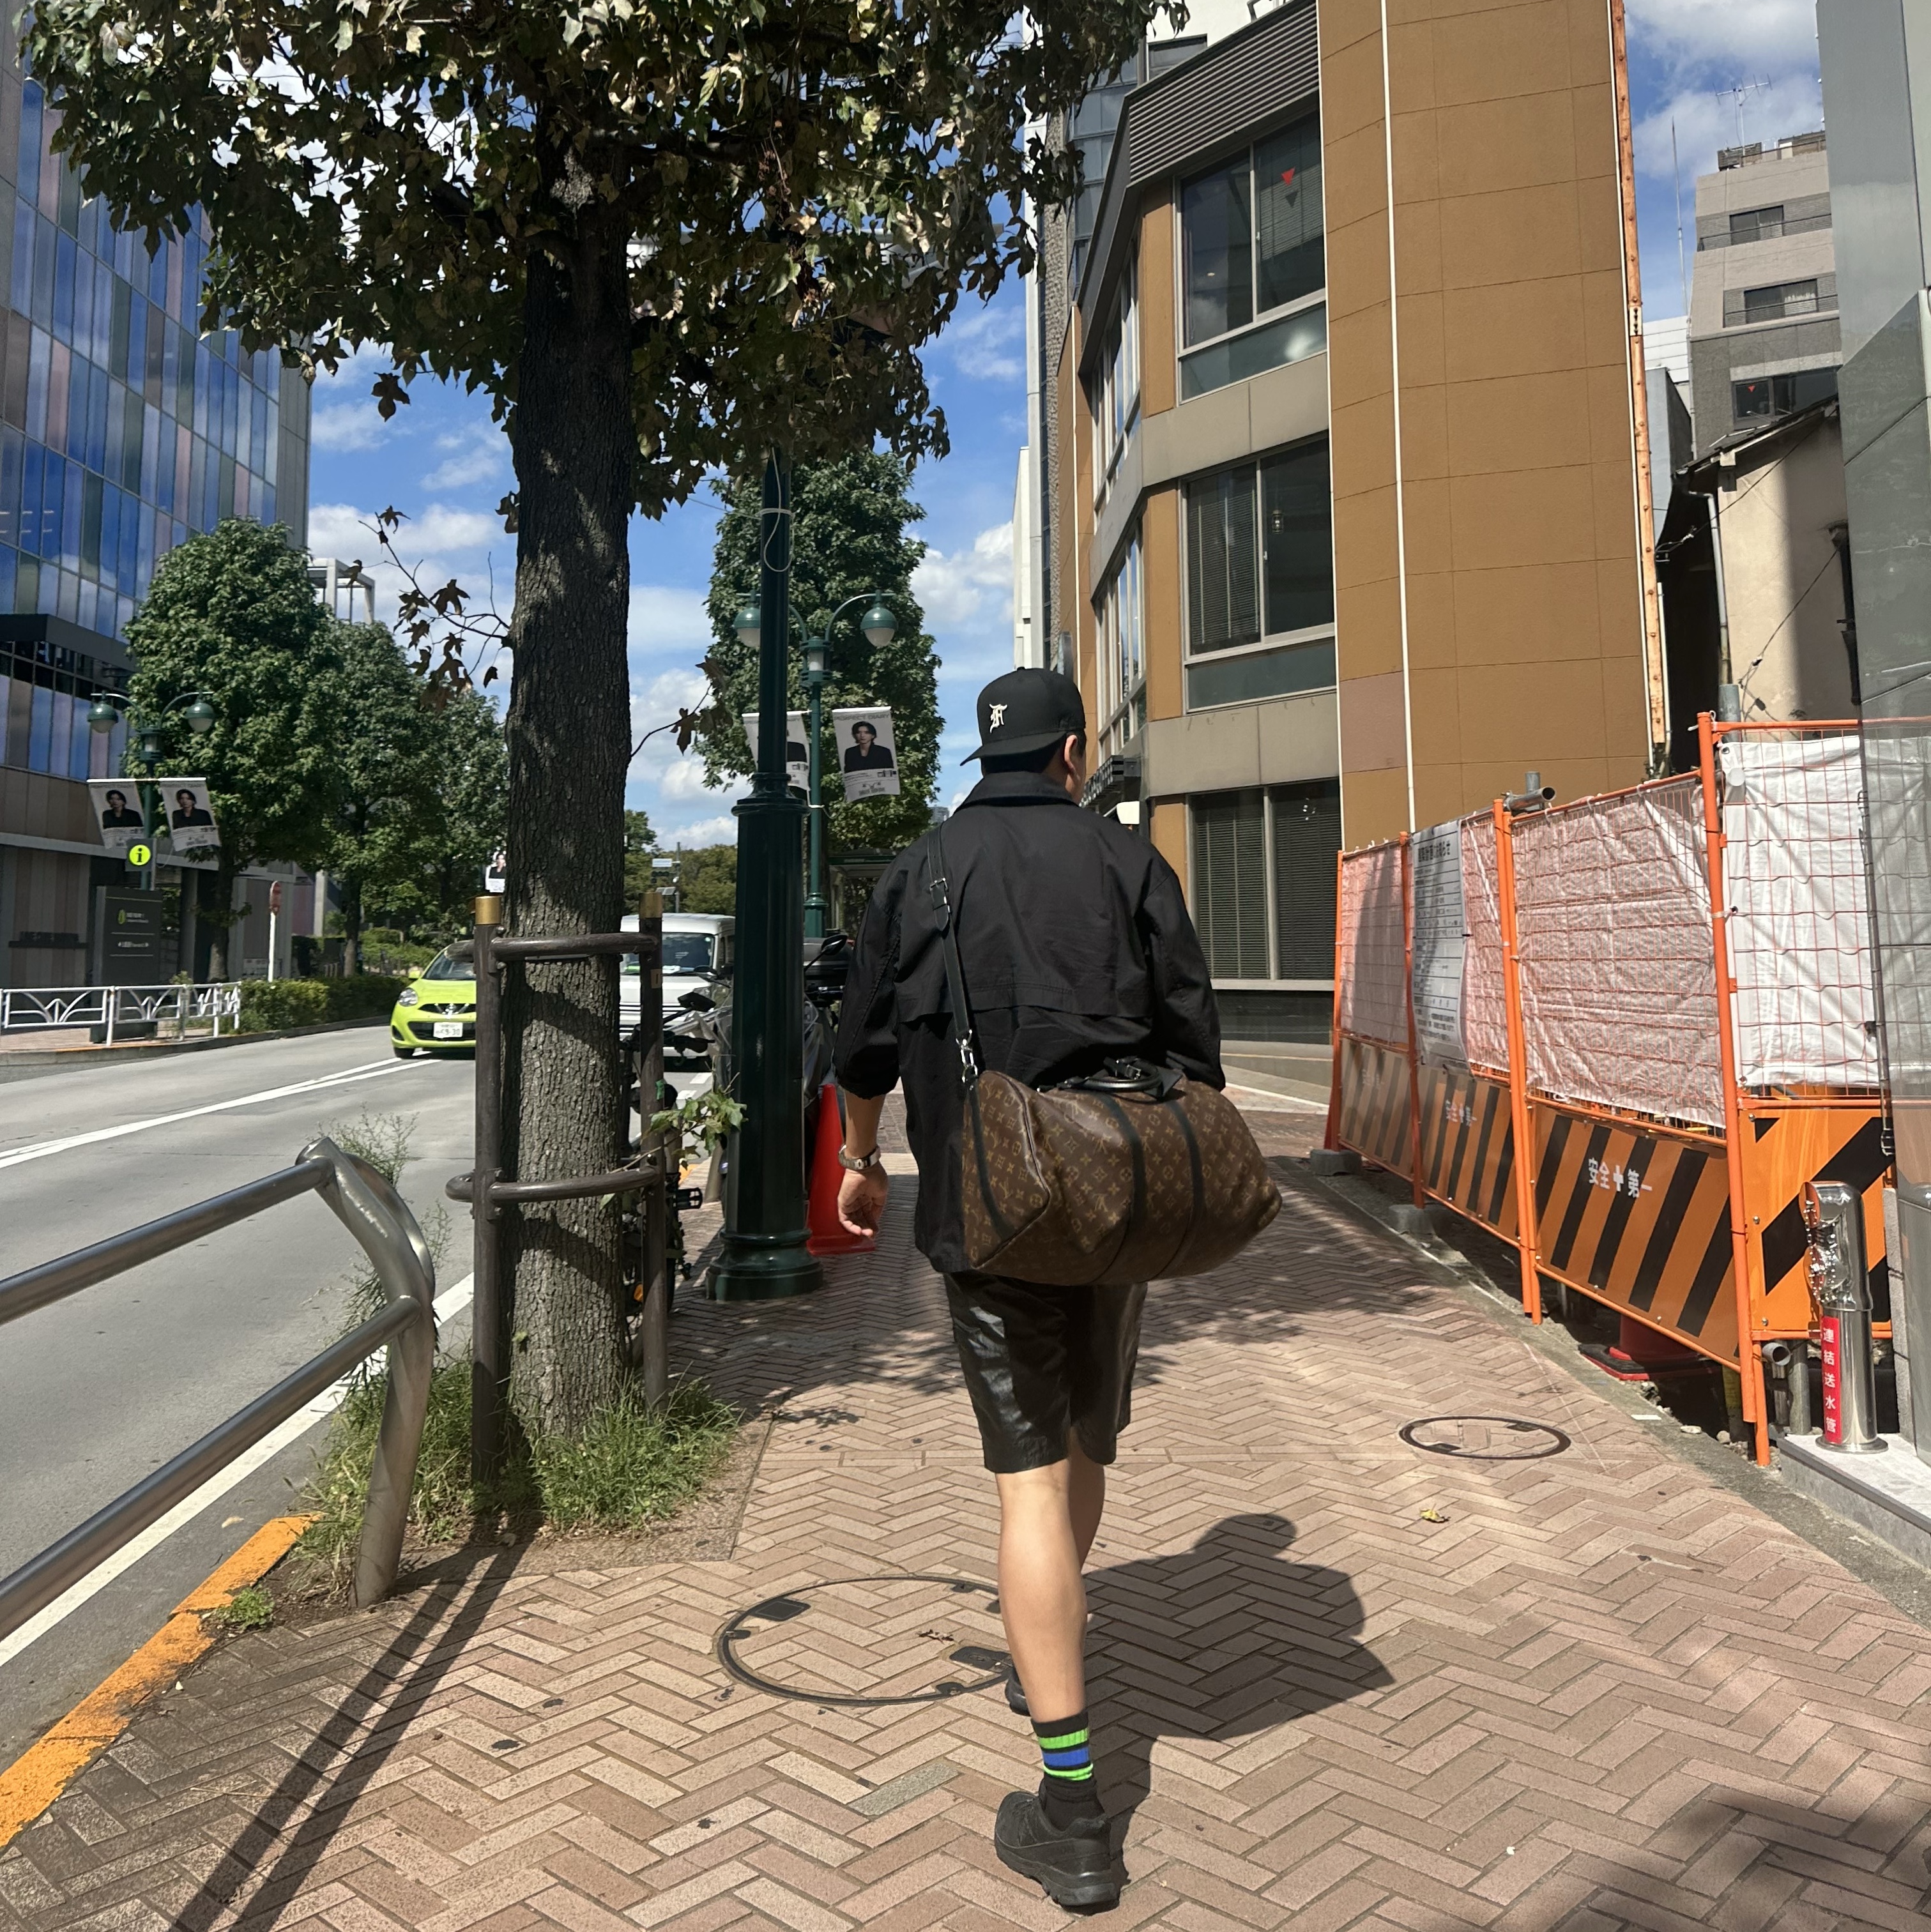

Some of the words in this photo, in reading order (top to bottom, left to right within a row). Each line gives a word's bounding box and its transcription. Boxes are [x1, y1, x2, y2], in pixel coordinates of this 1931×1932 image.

[1823, 1328, 1836, 1433] 連結送水管
